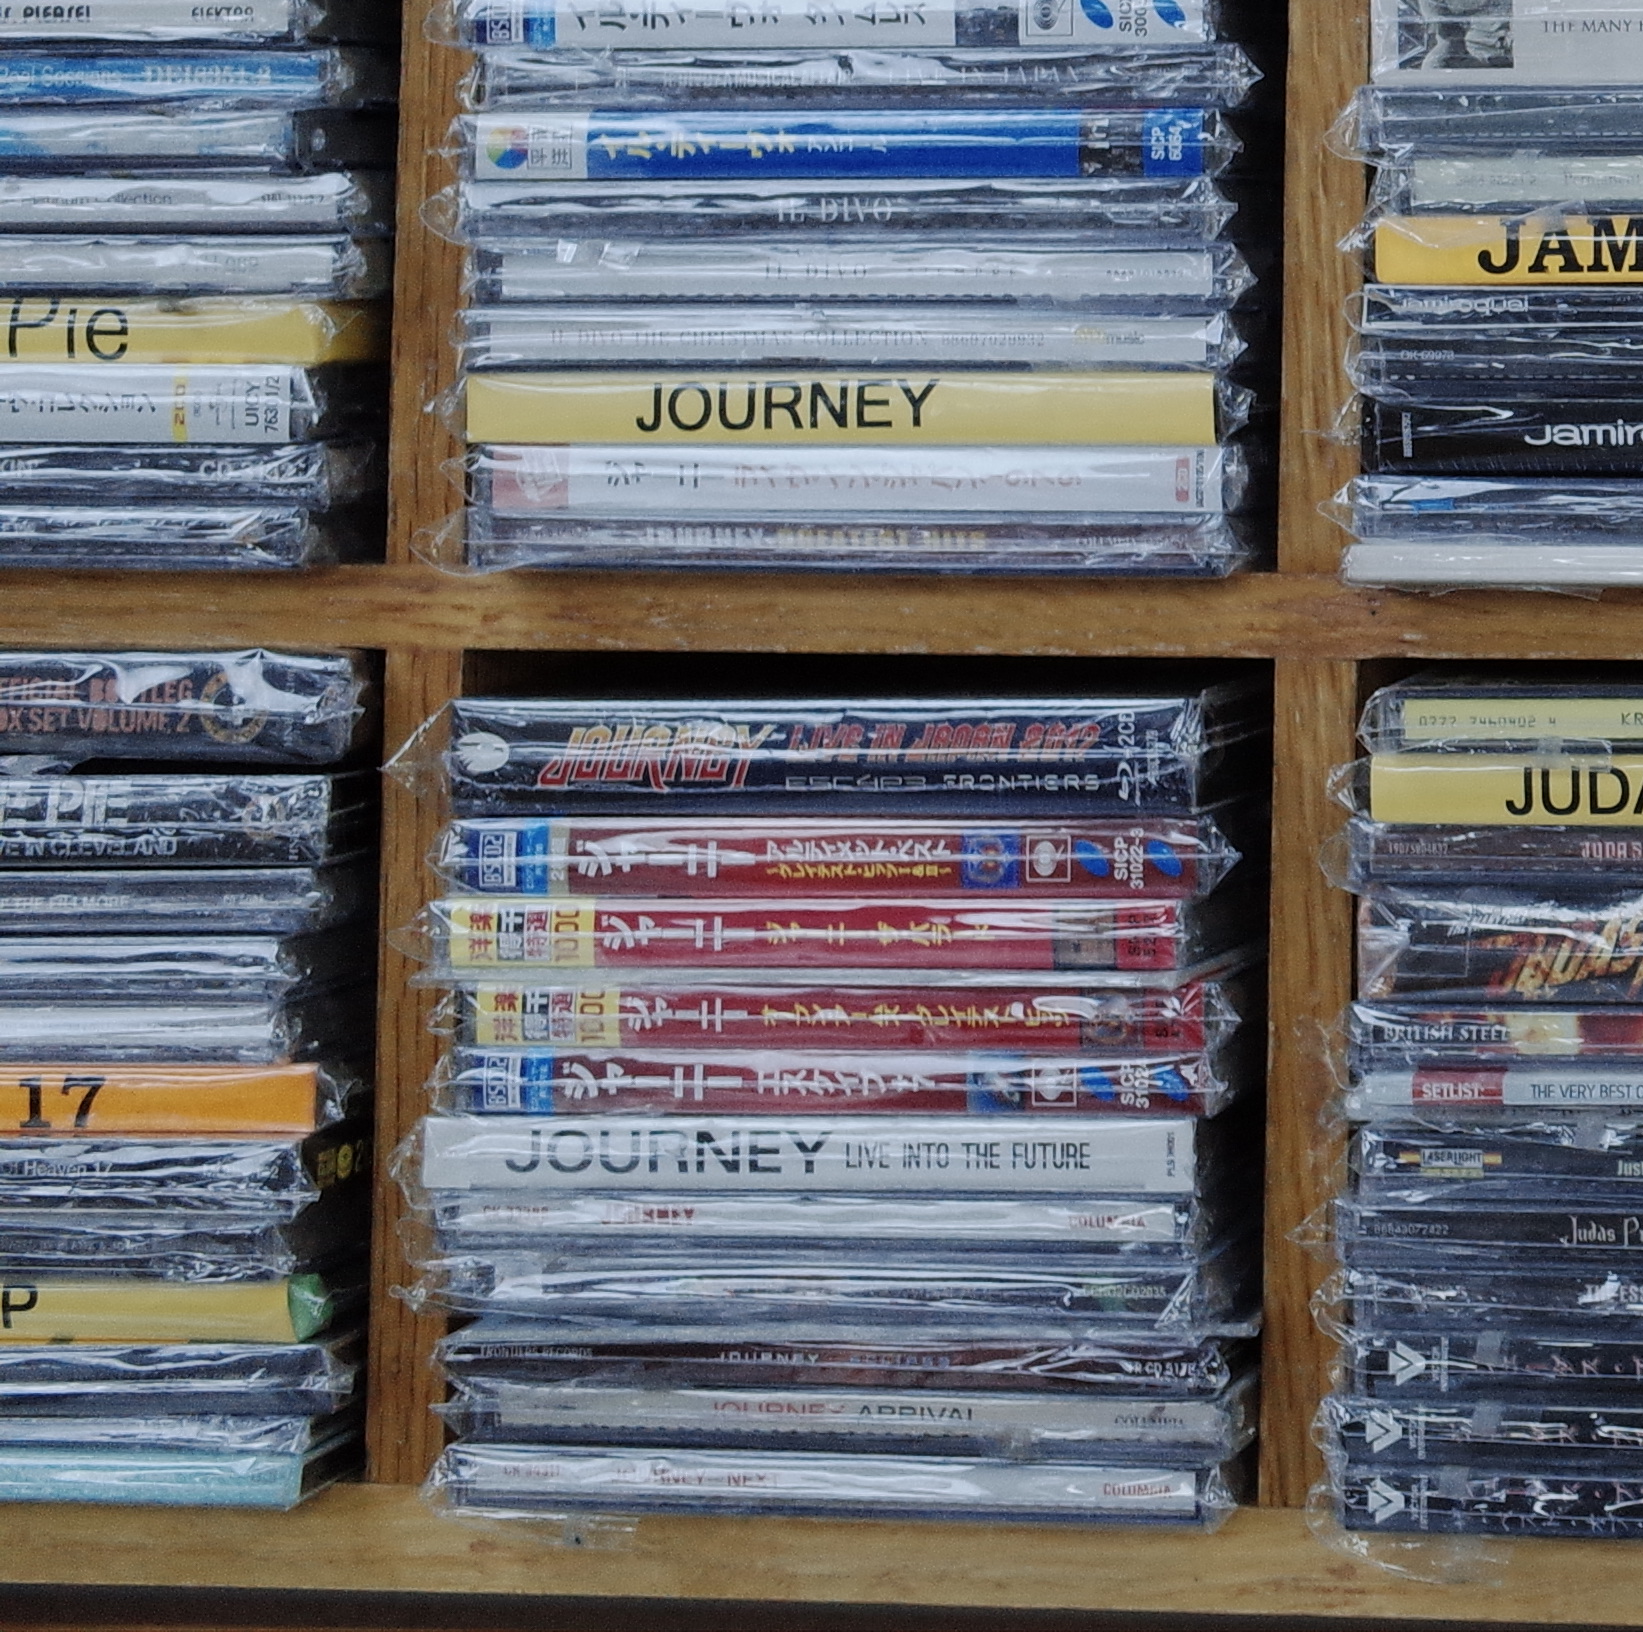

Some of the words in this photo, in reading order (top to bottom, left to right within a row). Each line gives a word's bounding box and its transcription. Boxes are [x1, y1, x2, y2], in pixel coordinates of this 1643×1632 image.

[1542, 20, 1577, 34] THE
[1581, 19, 1633, 34] MANY
[8, 296, 129, 360] Pie
[636, 380, 939, 433] JOURNEY
[1582, 842, 1643, 861] JUDAS
[19, 1075, 106, 1128] 17
[1531, 1084, 1553, 1100] THE
[1557, 1084, 1595, 1100] VERY
[1600, 1084, 1633, 1100] BEST
[505, 1129, 833, 1175] JOURNEY
[845, 1143, 895, 1171] LIVE
[902, 1142, 949, 1170] INTO
[962, 1142, 1003, 1170] THE
[1012, 1141, 1091, 1170] FUTURE
[1617, 1161, 1643, 1179] Just
[1, 1284, 38, 1328] P
